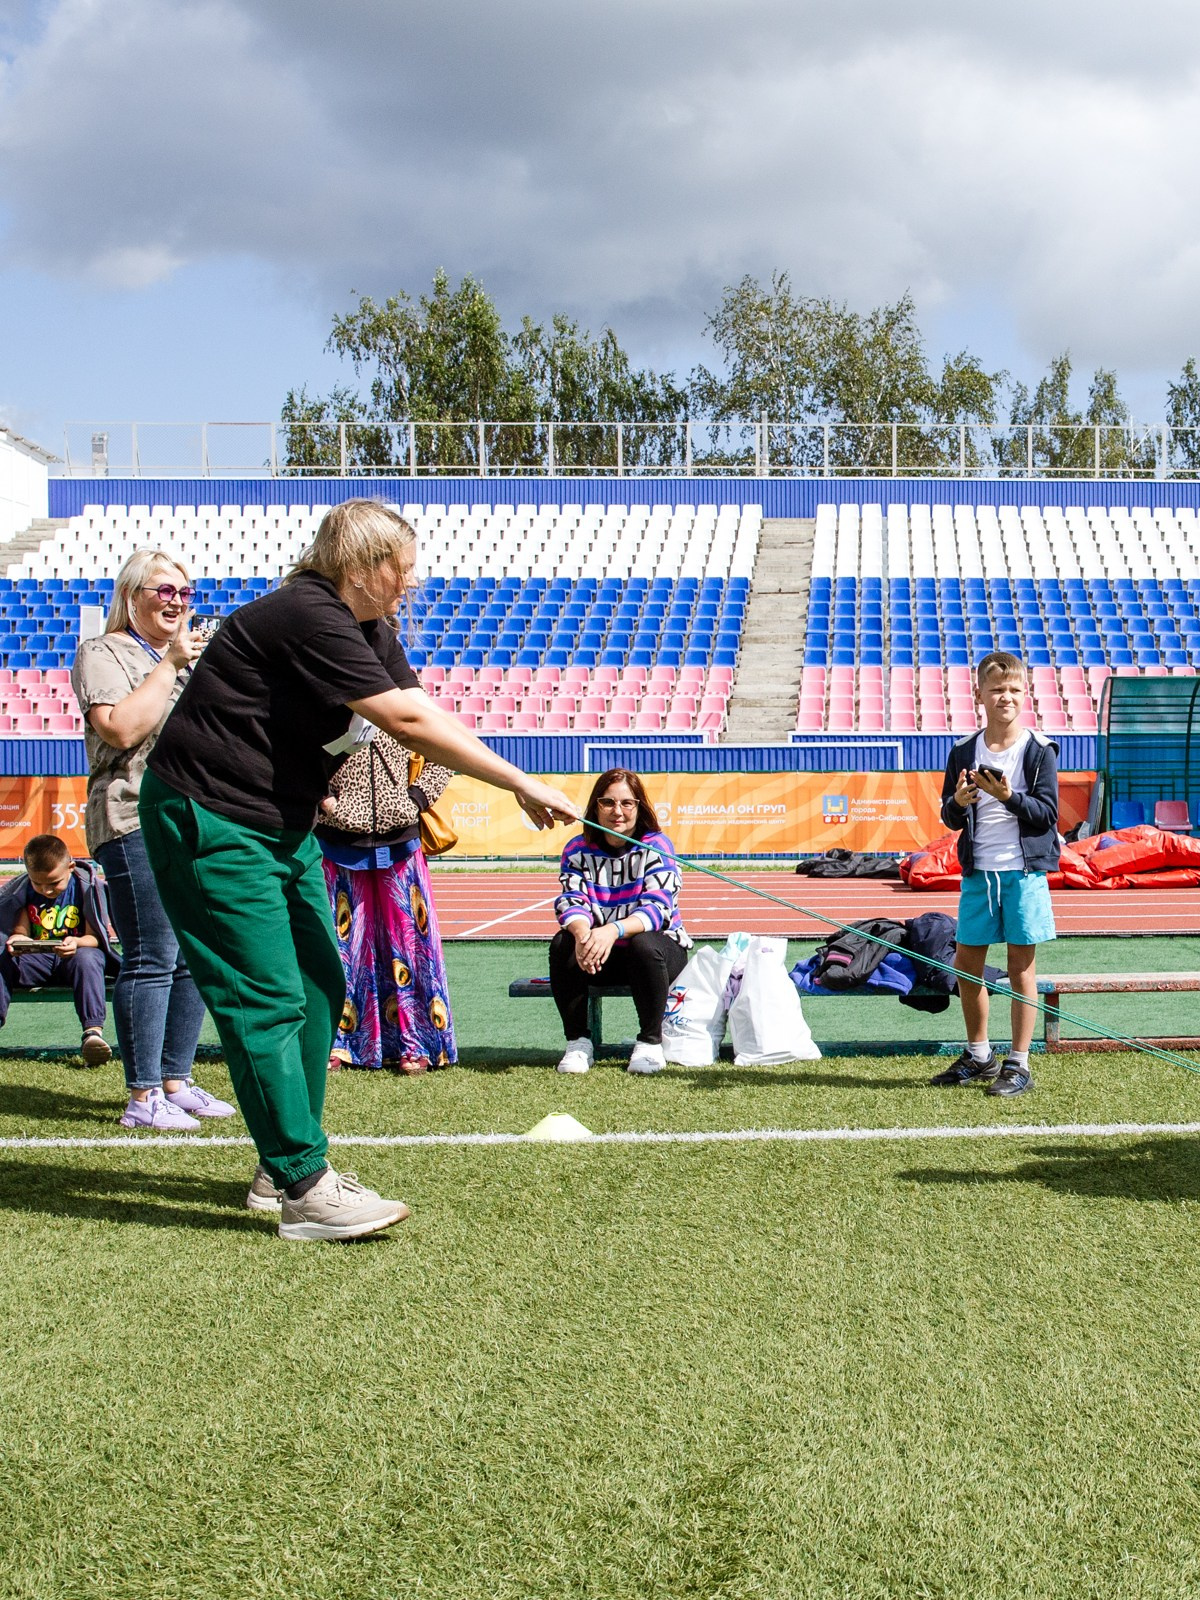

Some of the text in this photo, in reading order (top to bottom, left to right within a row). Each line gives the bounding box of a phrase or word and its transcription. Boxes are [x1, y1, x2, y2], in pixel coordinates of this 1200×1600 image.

[677, 805, 735, 816] МЕДИКАЛ
[737, 804, 755, 815] ОН
[757, 804, 787, 814] ГРУП
[452, 816, 492, 829] ПОРТ
